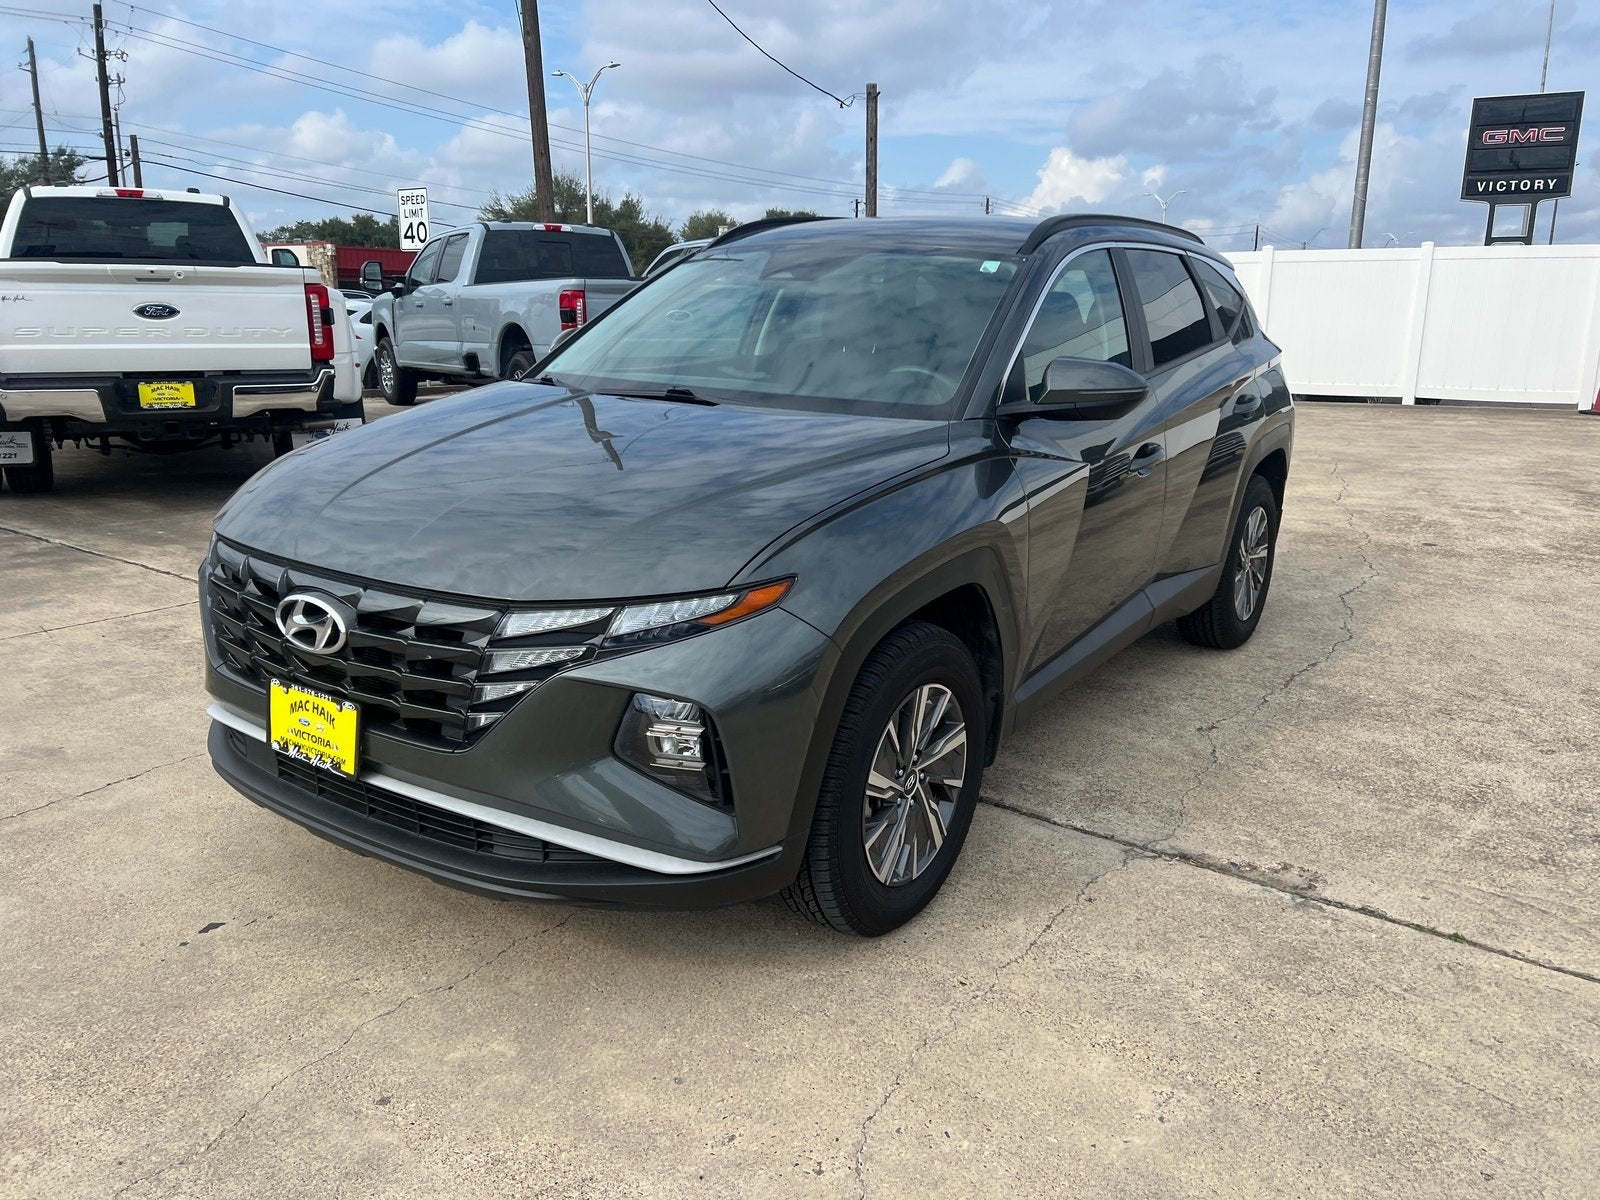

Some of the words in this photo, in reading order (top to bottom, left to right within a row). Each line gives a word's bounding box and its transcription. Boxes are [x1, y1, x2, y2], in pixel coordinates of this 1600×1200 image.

[1482, 127, 1565, 144] GMC
[1477, 179, 1557, 192] VICTORY
[401, 195, 425, 205] SPEED
[404, 208, 423, 218] LIMIT
[404, 221, 427, 243] 40
[14, 326, 172, 338] SUPER
[183, 326, 294, 338] DUTY
[151, 385, 164, 393] MAC
[290, 700, 310, 715] MAC
[312, 702, 336, 729] HAIK
[293, 728, 332, 749] VICTORIA
[287, 744, 310, 762] Mac
[309, 753, 338, 772] Haik
